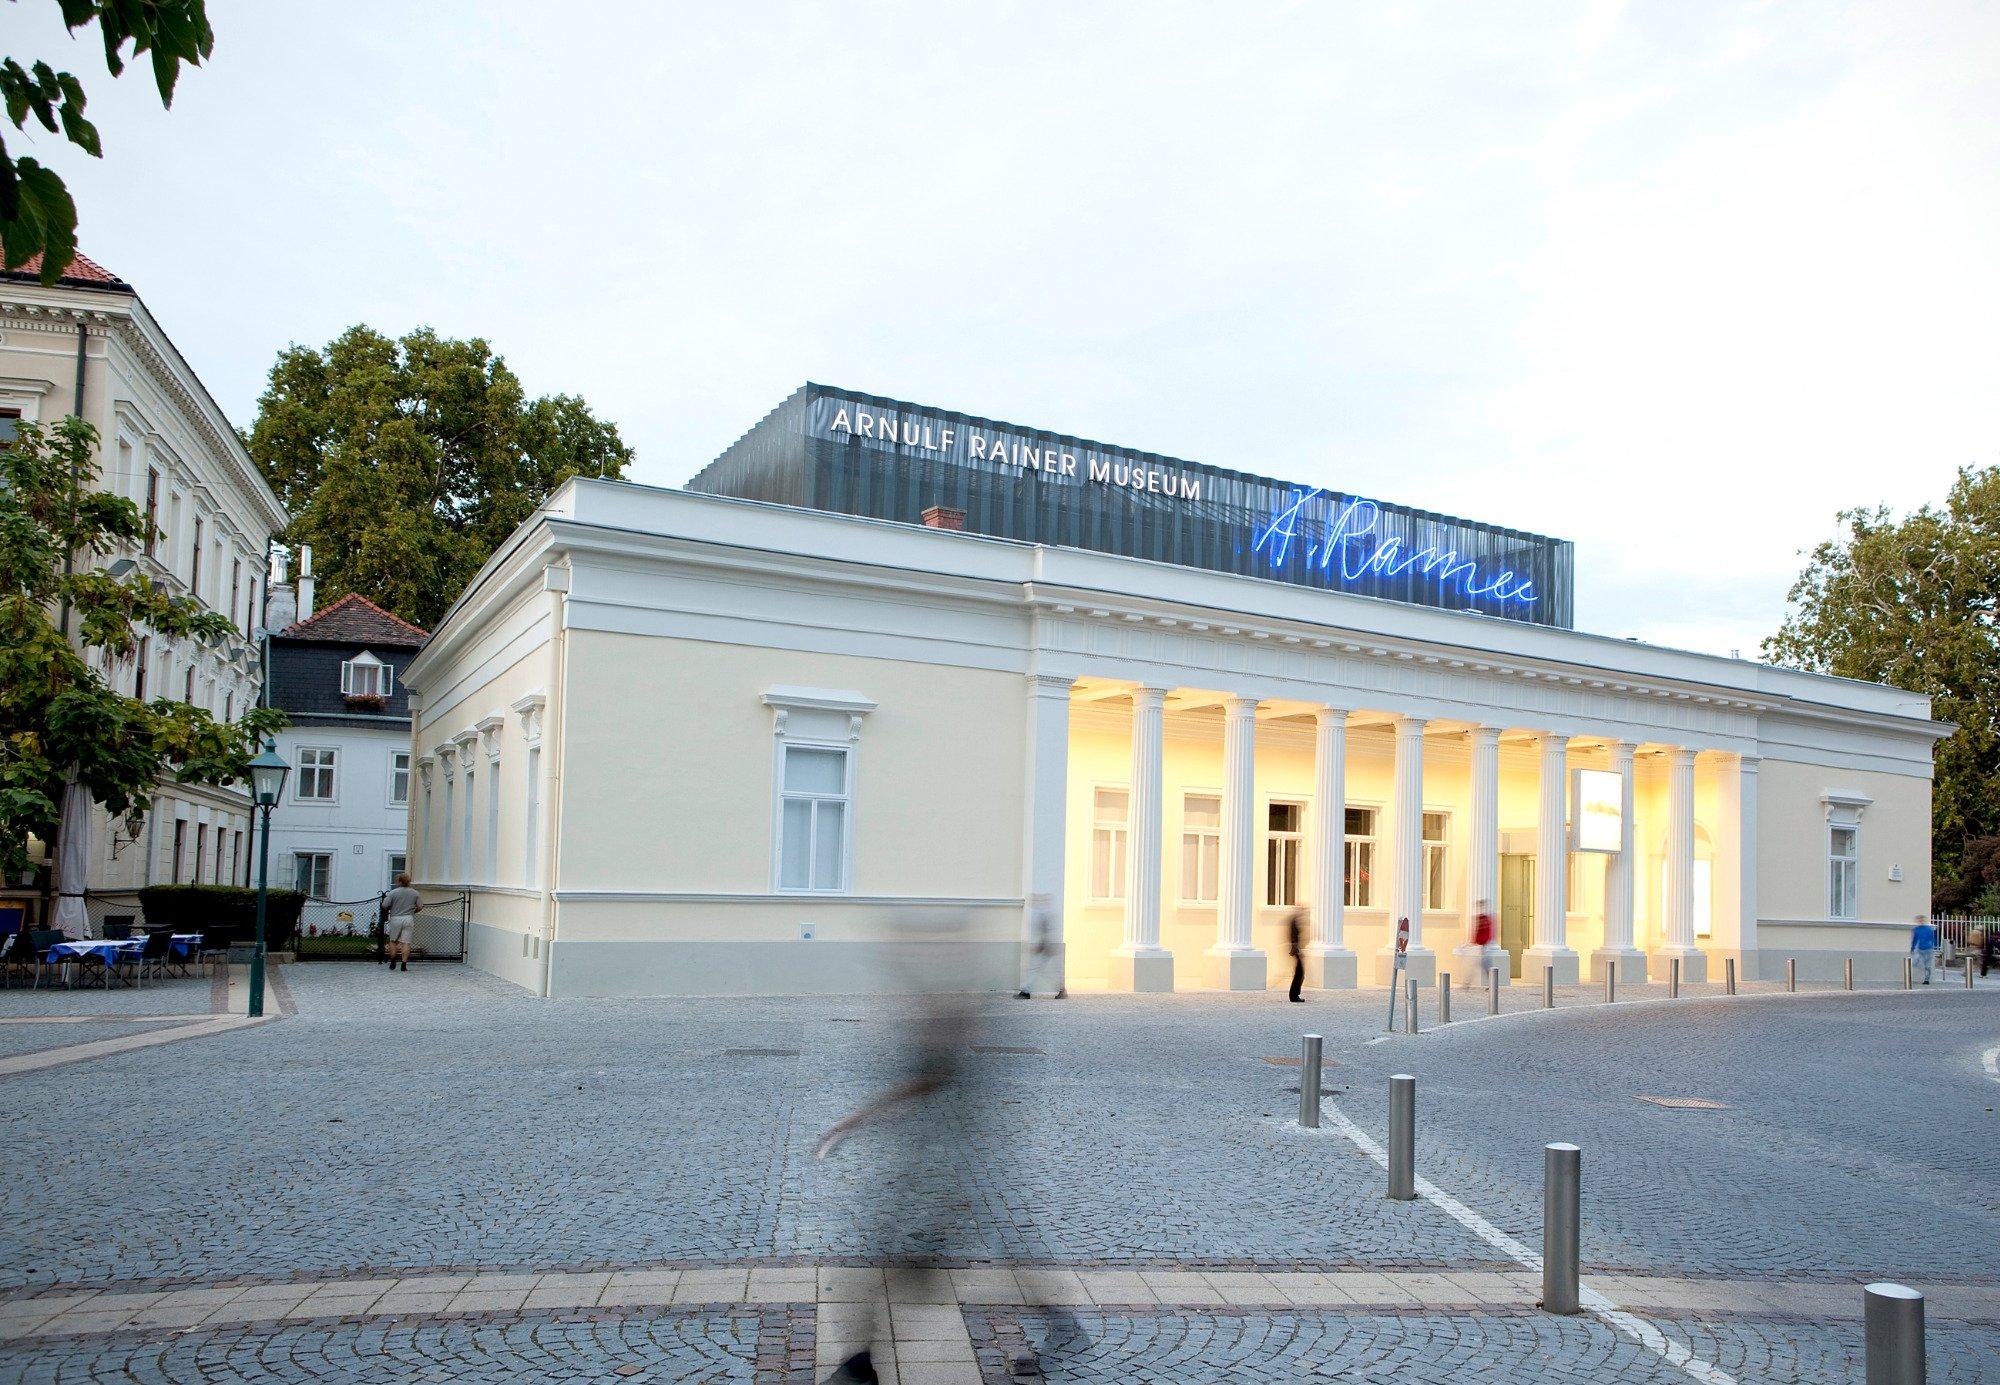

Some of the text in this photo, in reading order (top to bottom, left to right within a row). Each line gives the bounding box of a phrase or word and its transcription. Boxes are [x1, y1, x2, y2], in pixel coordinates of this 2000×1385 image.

[831, 408, 1201, 501] ARNULF RAINER MUSEUM
